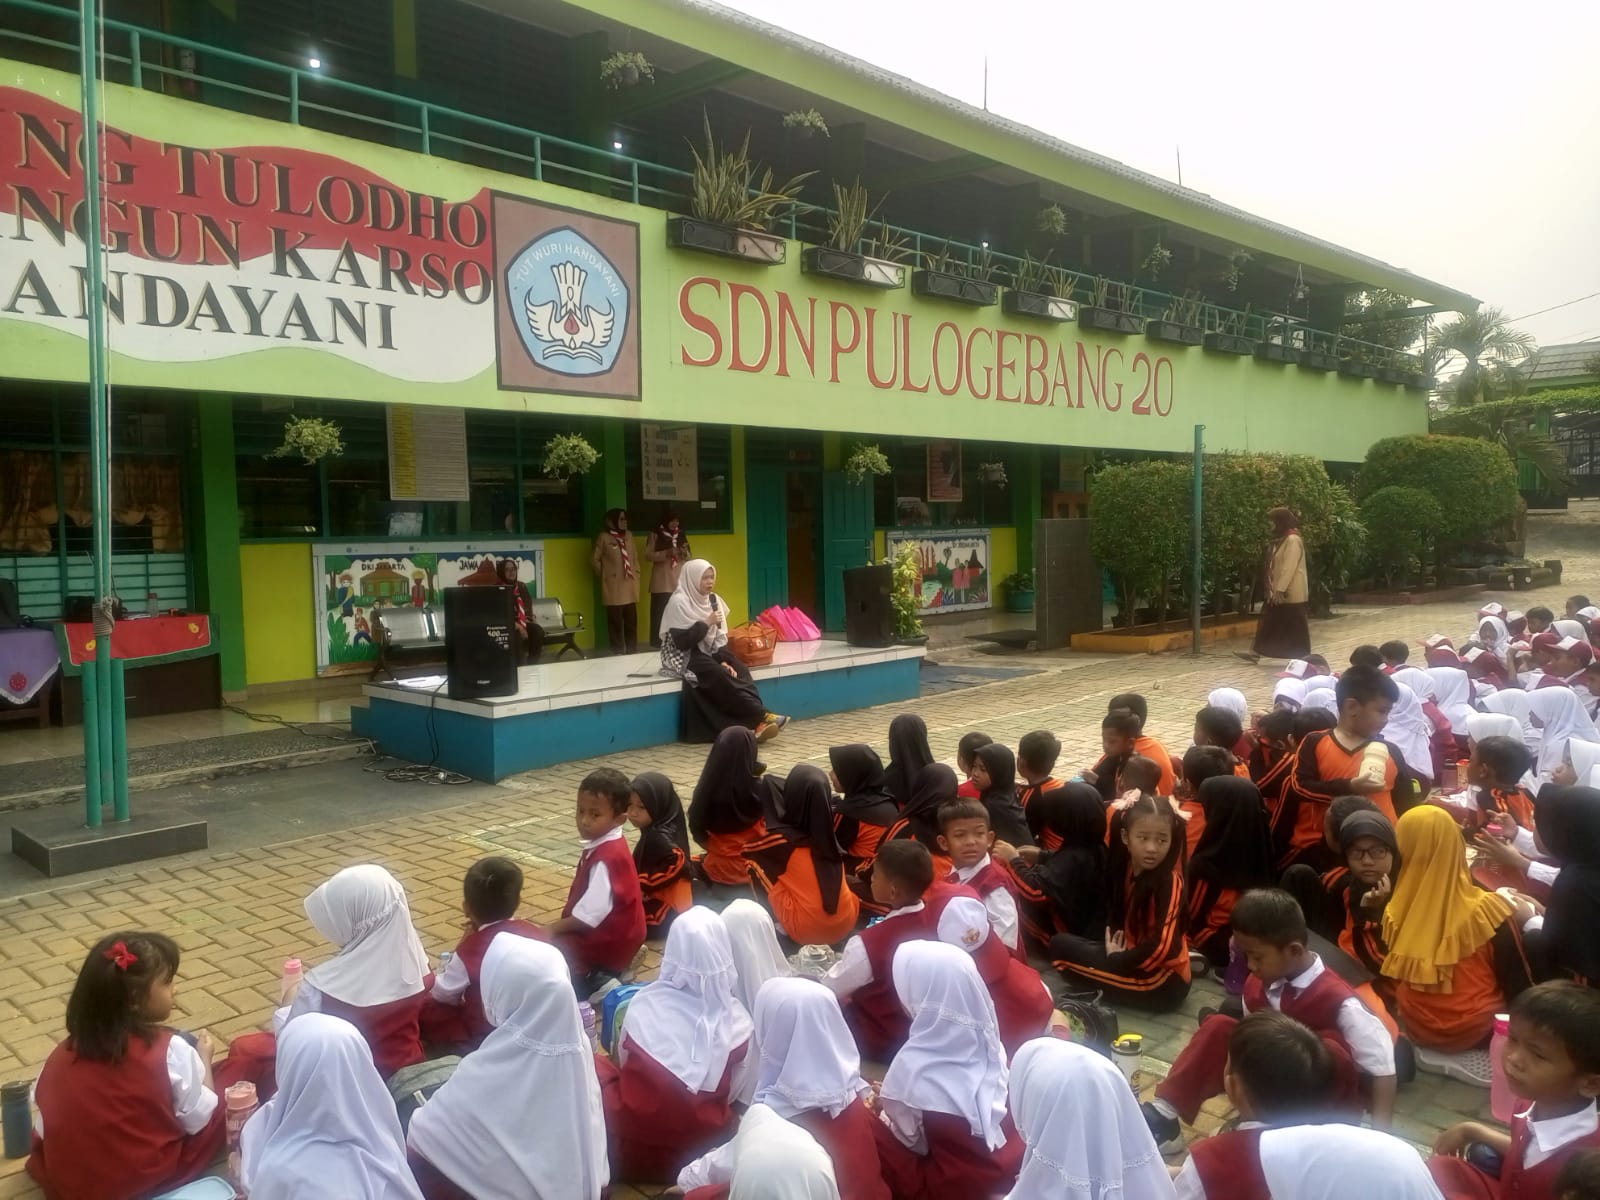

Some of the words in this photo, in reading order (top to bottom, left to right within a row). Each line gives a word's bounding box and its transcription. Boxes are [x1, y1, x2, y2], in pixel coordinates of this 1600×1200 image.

[0, 107, 137, 185] NG
[161, 142, 487, 249] TULODHO
[0, 183, 242, 272] NGUN
[266, 226, 492, 306] KARSO
[516, 260, 535, 282] TUT
[534, 243, 562, 261] WURI
[565, 244, 621, 297] HANDAYANI
[677, 275, 818, 379] SDN
[828, 300, 1124, 412] PULOGEBANG
[1131, 351, 1174, 417] 20
[459, 560, 479, 570] JAWA
